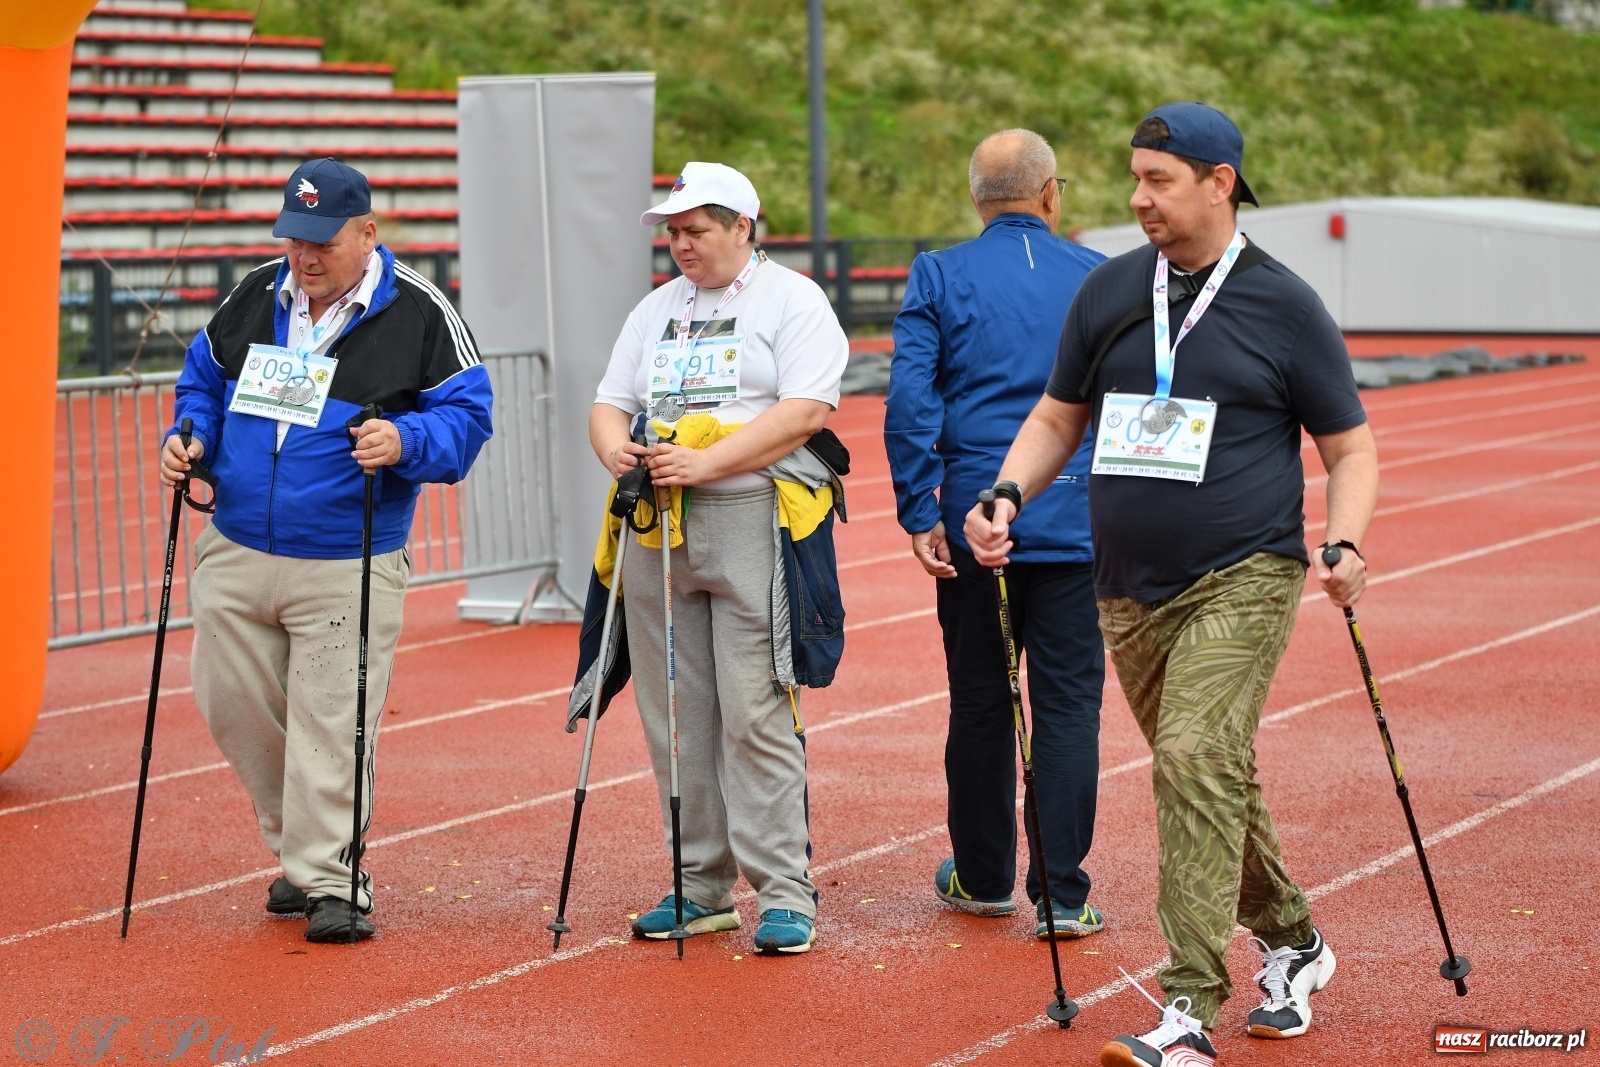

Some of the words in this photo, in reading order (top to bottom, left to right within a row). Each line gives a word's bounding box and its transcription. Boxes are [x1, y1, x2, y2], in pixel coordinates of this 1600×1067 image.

[263, 358, 308, 386] 09
[686, 354, 716, 377] 91
[1000, 598, 1014, 657] KOMPERDELL
